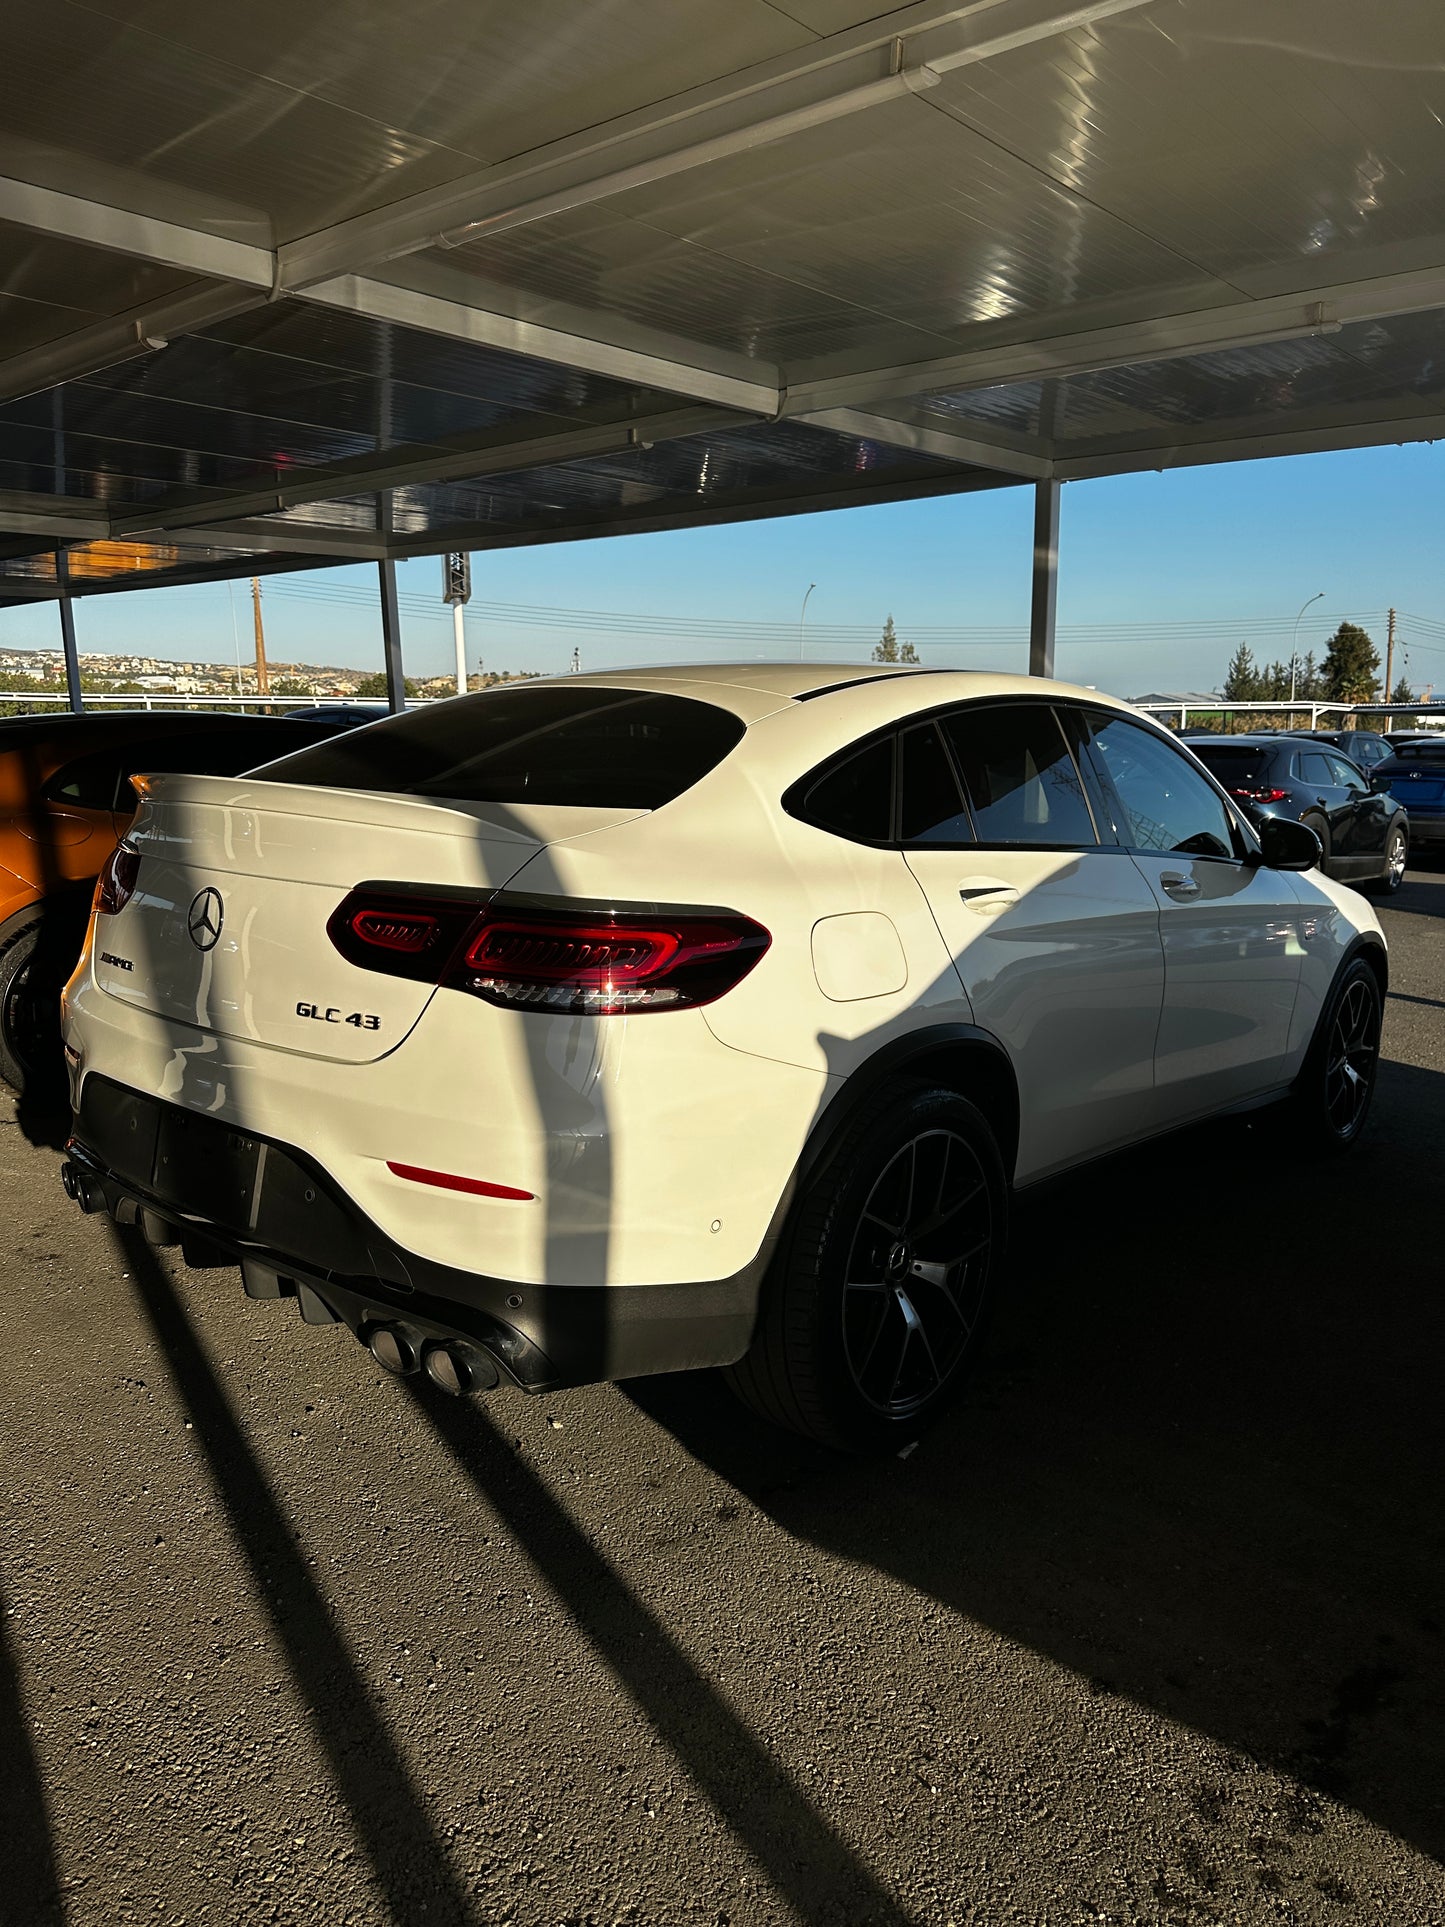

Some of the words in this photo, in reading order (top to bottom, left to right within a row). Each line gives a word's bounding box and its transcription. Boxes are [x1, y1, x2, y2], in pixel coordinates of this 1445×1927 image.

[103, 951, 134, 971] AMG
[296, 1002, 340, 1023] GLC
[345, 1013, 380, 1030] 43
